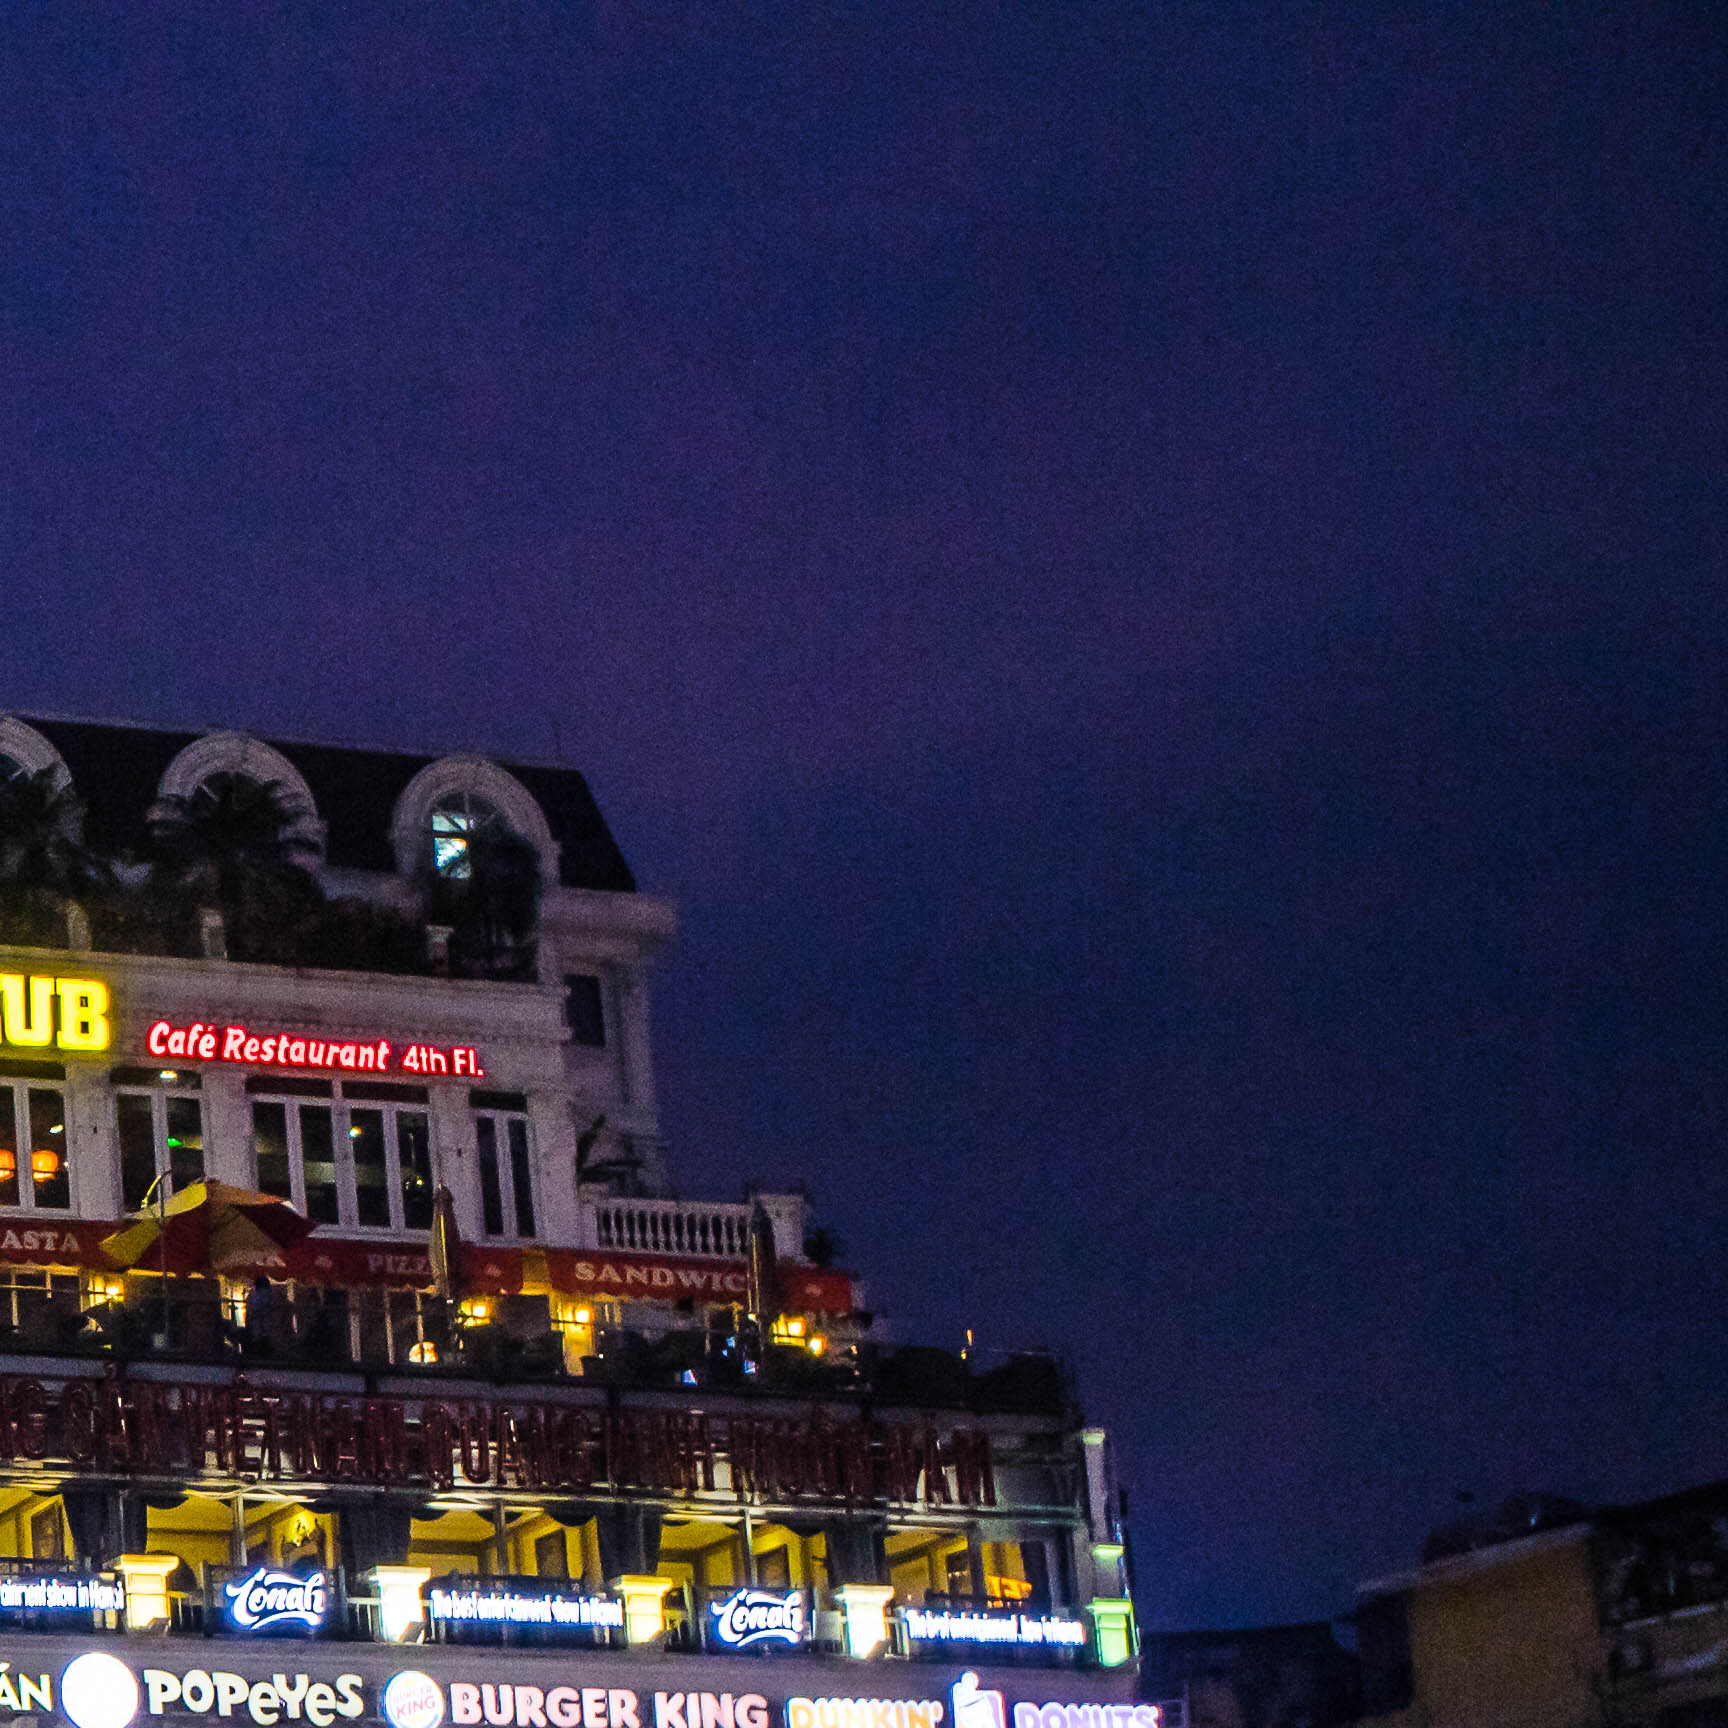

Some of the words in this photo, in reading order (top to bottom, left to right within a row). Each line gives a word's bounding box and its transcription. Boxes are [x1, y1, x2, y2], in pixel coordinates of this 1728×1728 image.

[147, 1019, 217, 1060] Café
[221, 1026, 390, 1073] Restaurant
[401, 1042, 446, 1075] 4th
[366, 1253, 432, 1275] PIZZ
[574, 1260, 747, 1294] SANDWIC
[396, 1695, 436, 1719] KING
